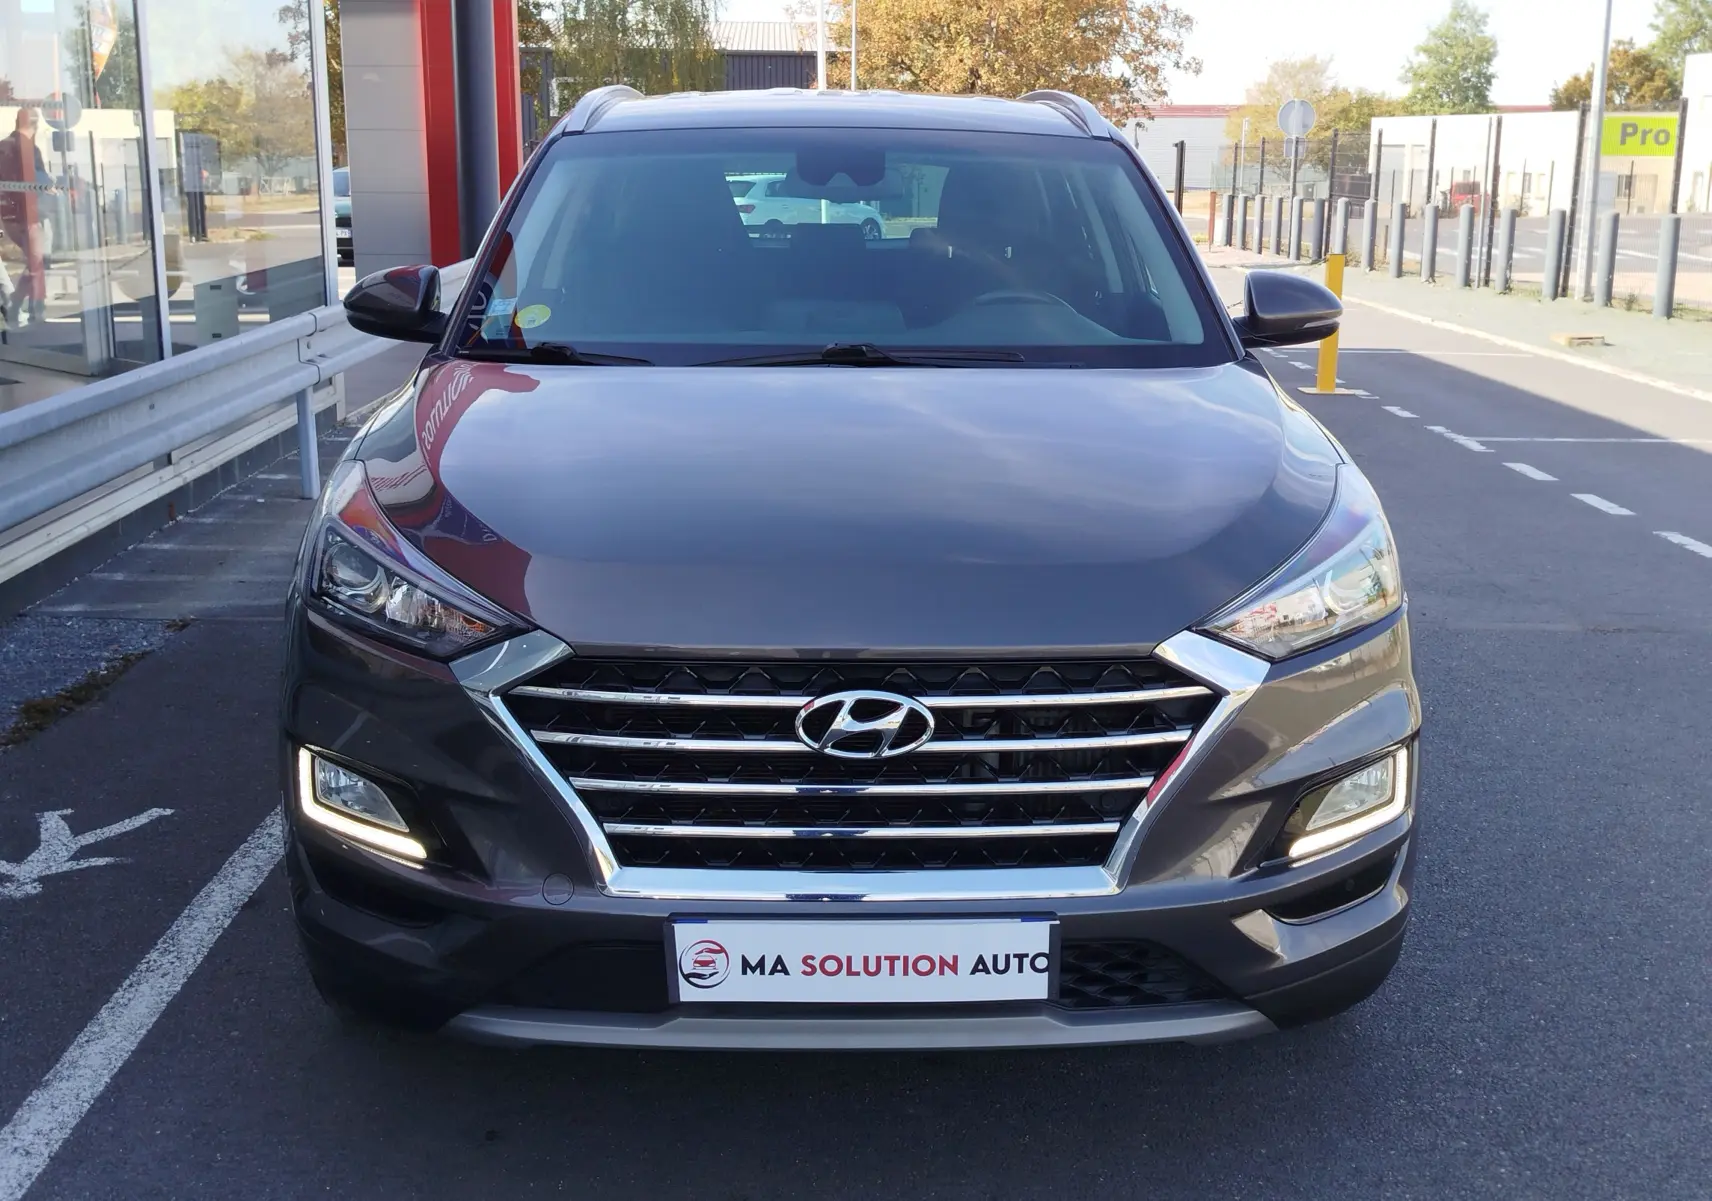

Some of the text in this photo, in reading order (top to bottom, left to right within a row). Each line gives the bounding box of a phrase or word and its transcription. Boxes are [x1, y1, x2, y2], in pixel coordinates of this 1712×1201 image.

[1620, 123, 1671, 146] Pro
[741, 951, 1050, 977] MA SOLUTION AUTO
